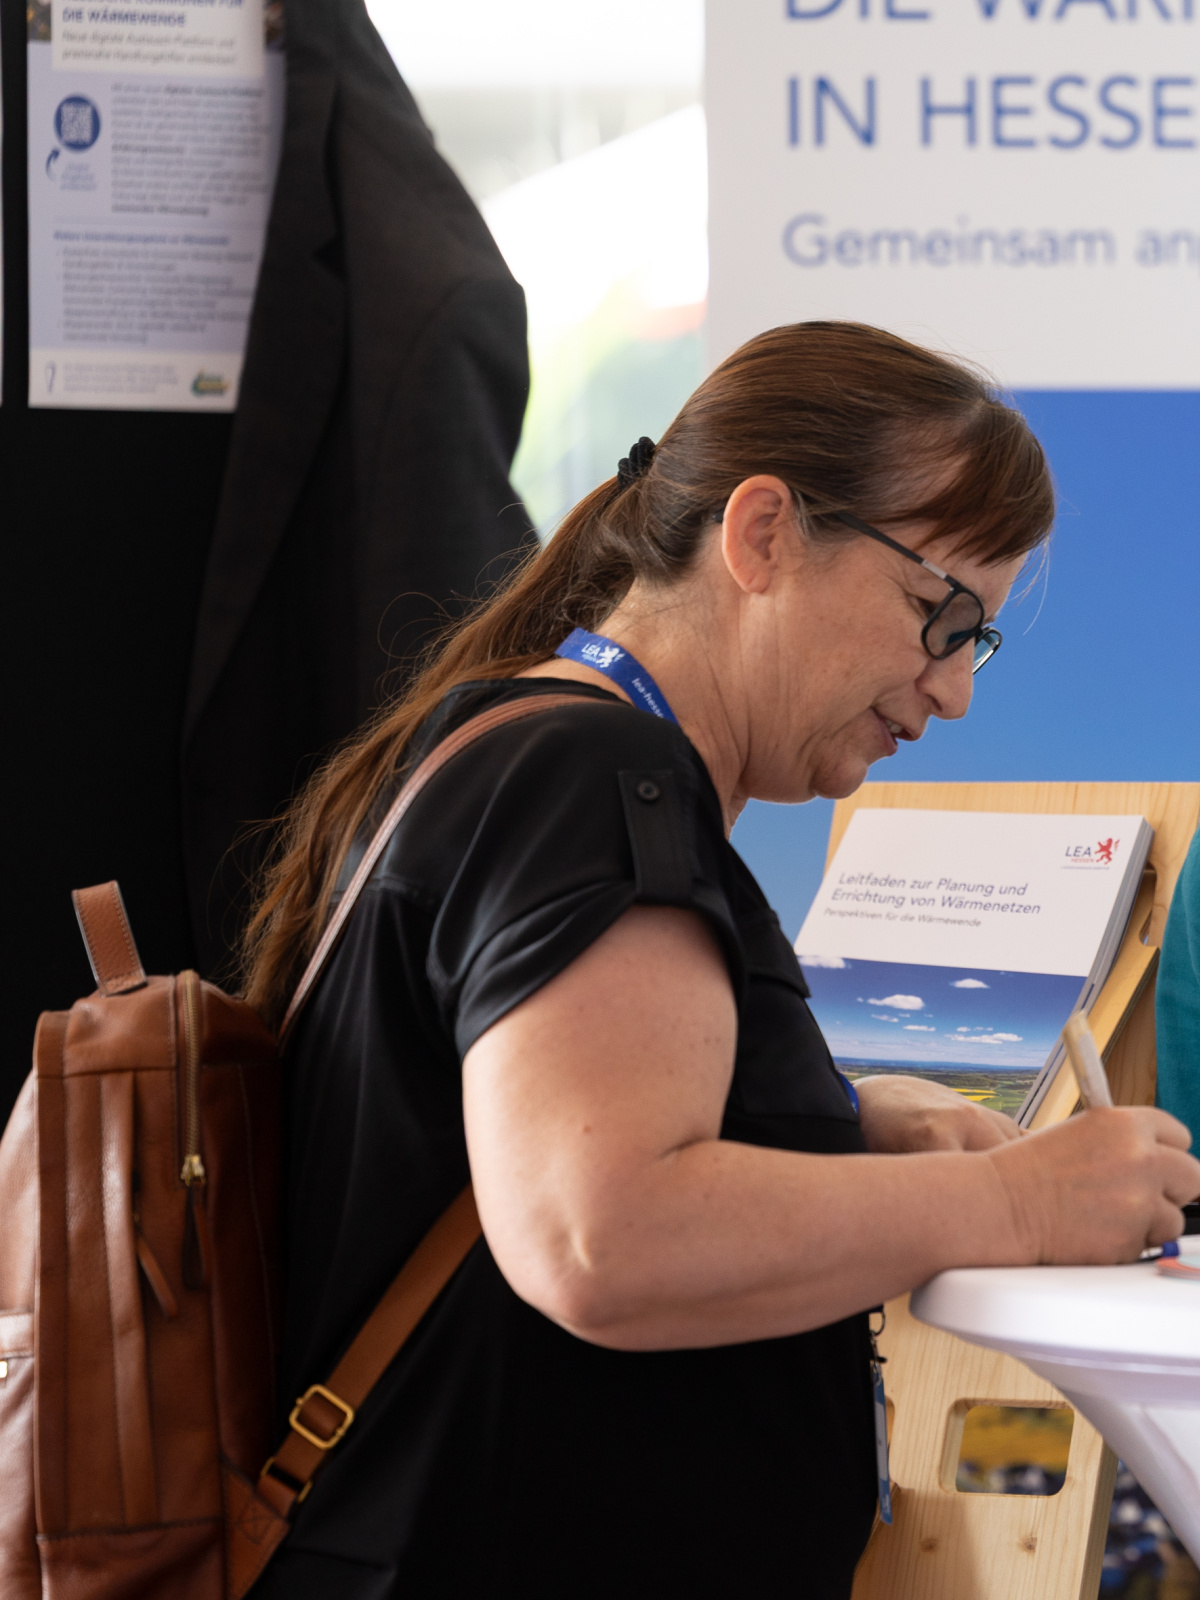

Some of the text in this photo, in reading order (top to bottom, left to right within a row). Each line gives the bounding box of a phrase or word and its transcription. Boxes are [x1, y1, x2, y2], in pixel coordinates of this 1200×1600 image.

[786, 73, 878, 149] IN
[780, 211, 1117, 270] Gemeinsam
[1065, 845, 1092, 857] LEA
[838, 872, 1028, 897] Leitfaden zur Planung und
[831, 888, 1041, 915] Errichtung von Wärmenetzen
[900, 913, 915, 922] die
